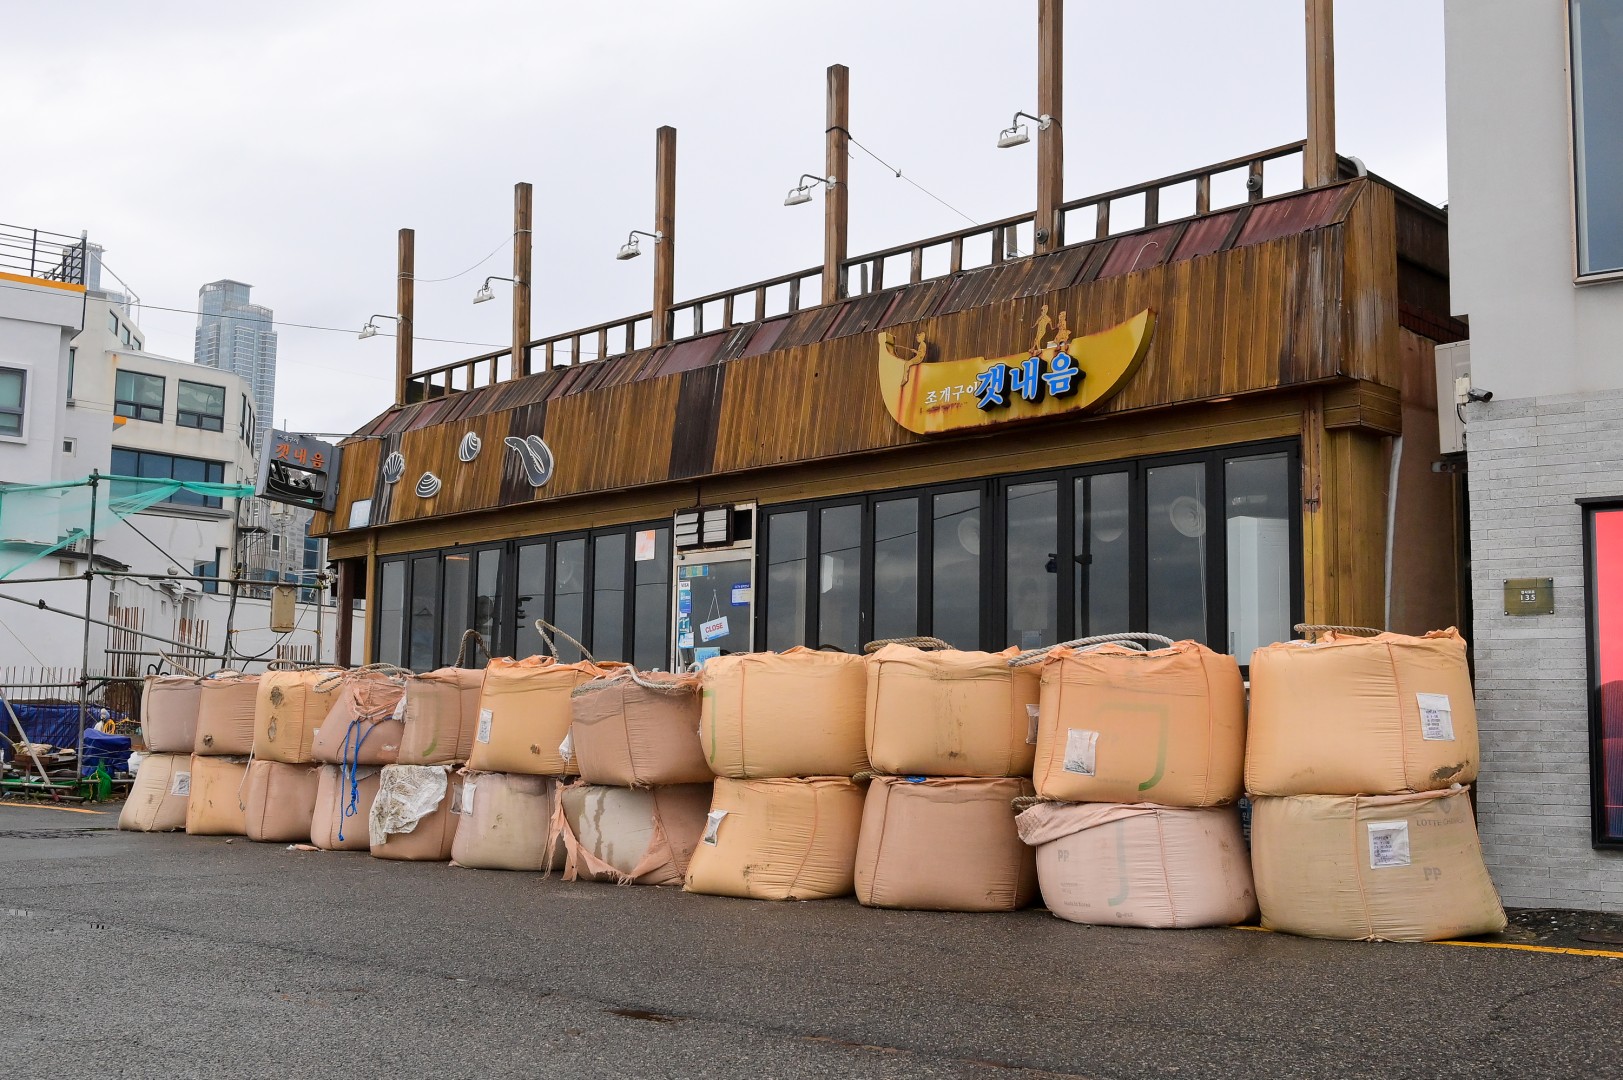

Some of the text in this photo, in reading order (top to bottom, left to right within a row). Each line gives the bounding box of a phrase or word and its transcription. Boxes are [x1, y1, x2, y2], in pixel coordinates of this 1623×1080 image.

[974, 353, 1078, 409] 갯내음
[275, 443, 325, 469] 갯내음
[705, 623, 723, 633] CLOSE
[1423, 867, 1441, 880] PP
